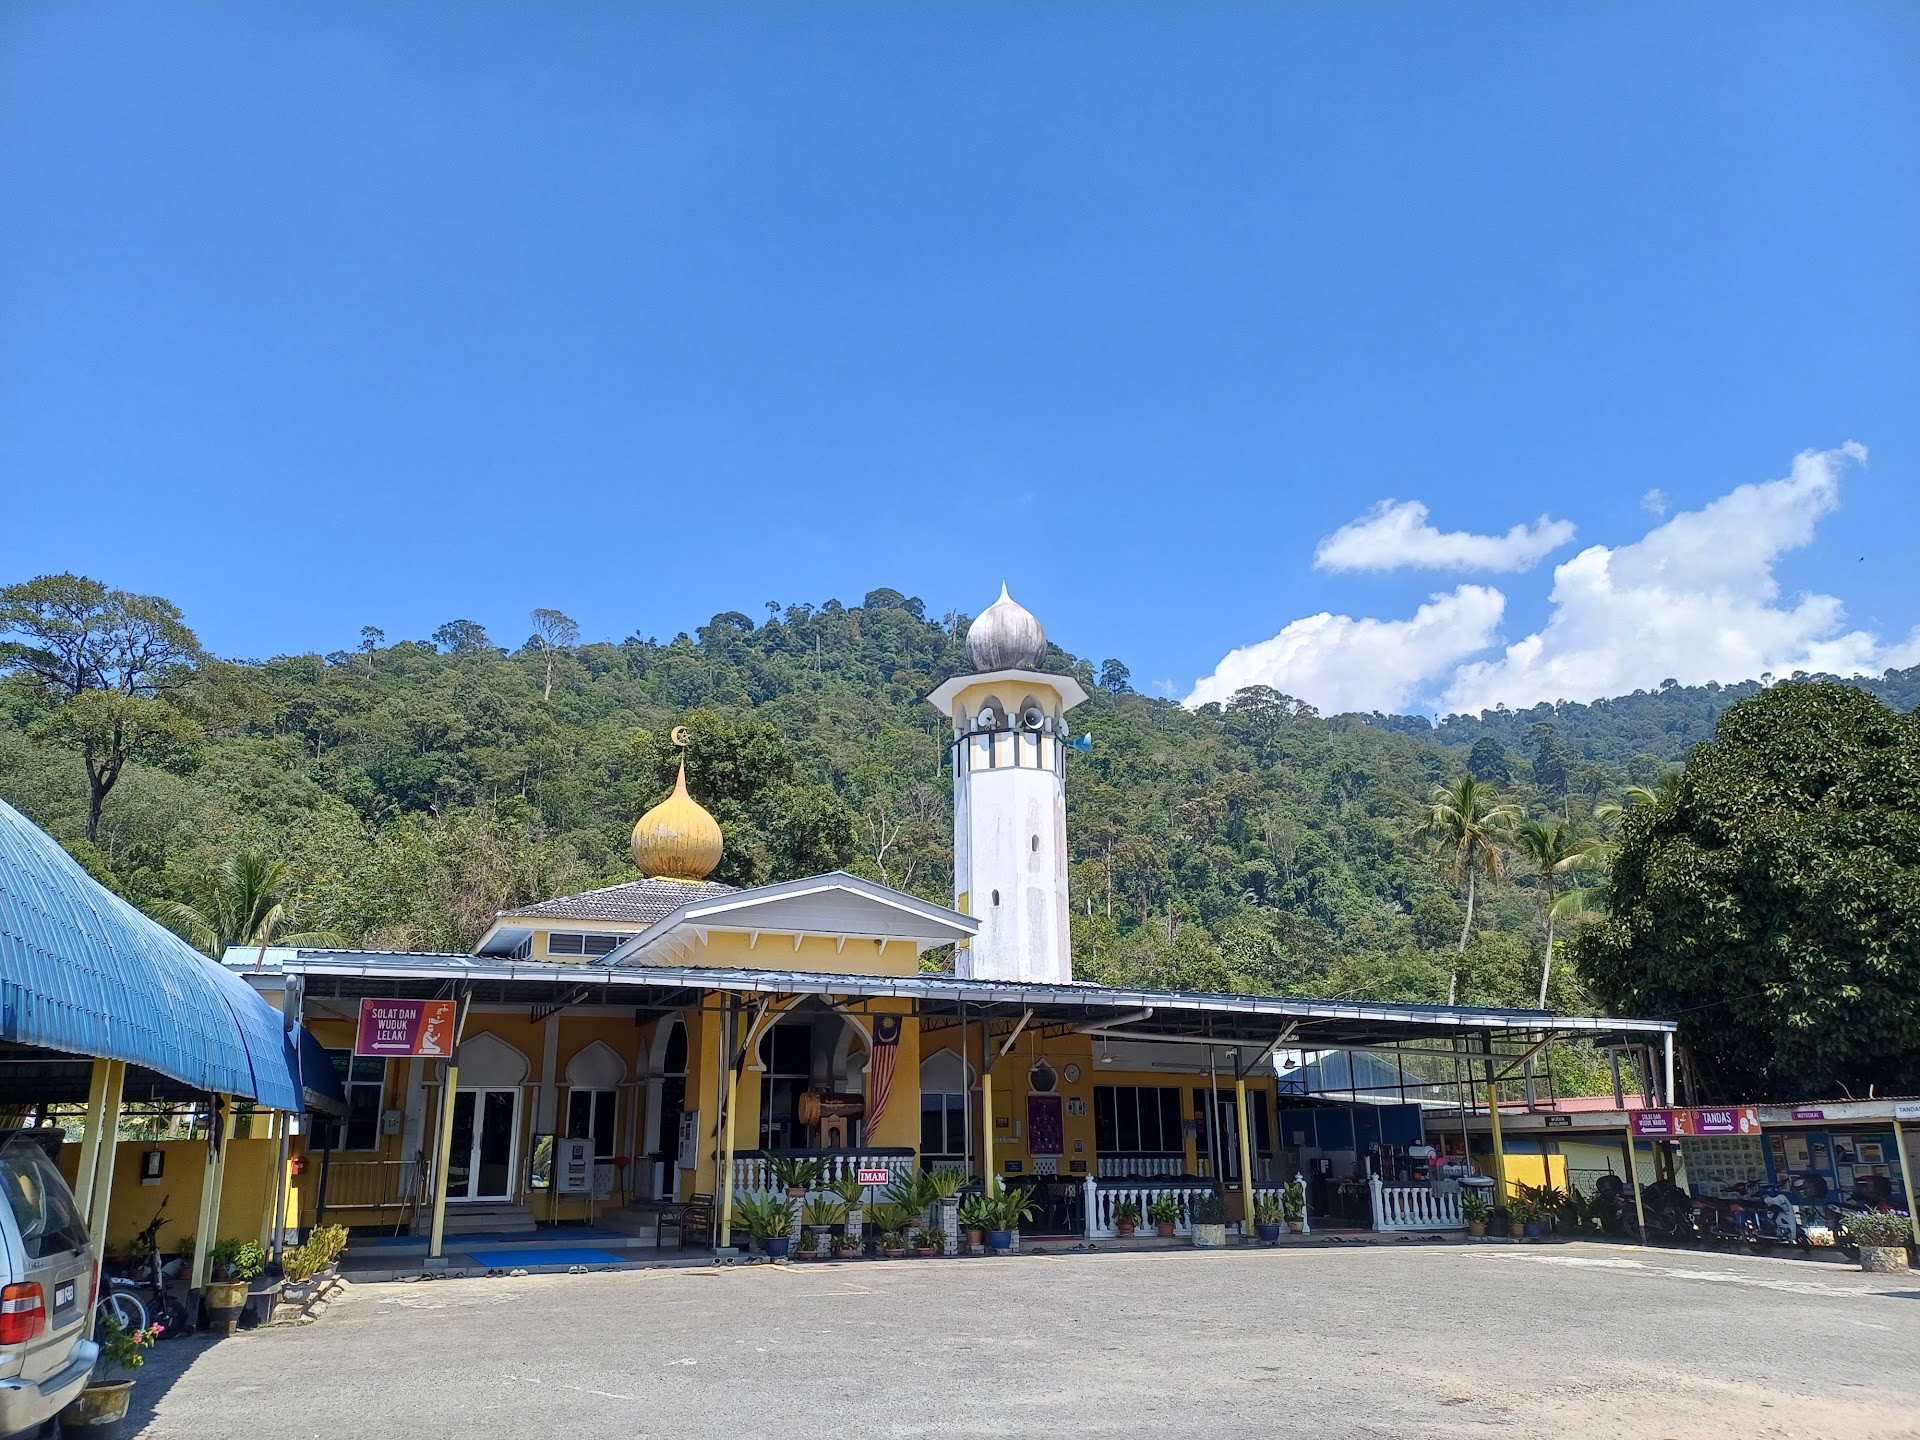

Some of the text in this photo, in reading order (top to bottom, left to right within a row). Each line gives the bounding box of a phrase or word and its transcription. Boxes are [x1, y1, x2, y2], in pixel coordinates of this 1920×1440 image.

[371, 1008, 416, 1019] SOLAT DAN
[378, 1019, 408, 1030] WUDUK
[377, 1030, 406, 1041] LELAKI
[1702, 1111, 1732, 1123] TANDAS
[860, 1172, 886, 1181] IMAM
